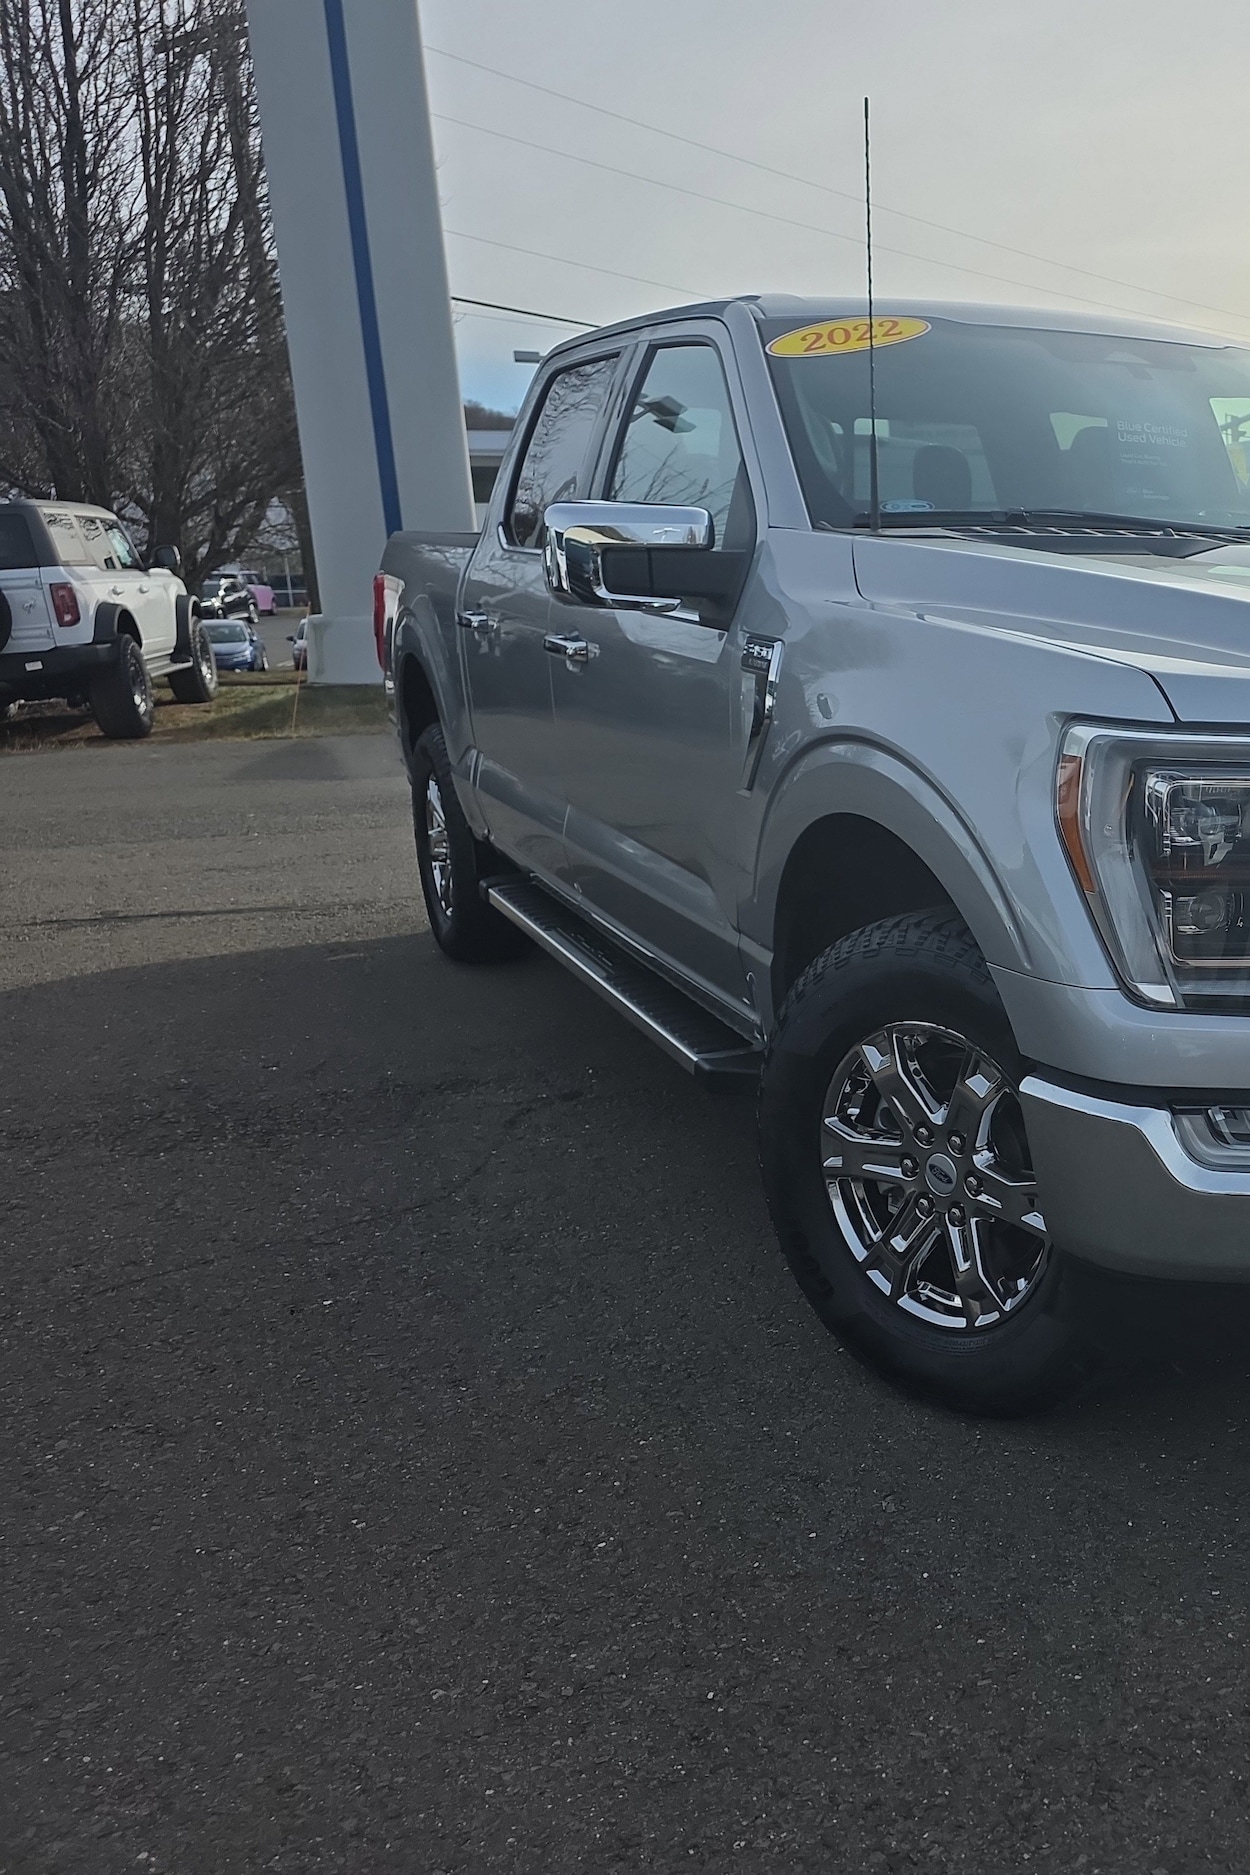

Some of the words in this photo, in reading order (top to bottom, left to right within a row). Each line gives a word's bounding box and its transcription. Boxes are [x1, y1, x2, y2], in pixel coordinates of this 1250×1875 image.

[801, 319, 903, 353] 2022
[1117, 420, 1142, 432] Blue
[1143, 422, 1188, 438] Certified
[1118, 431, 1147, 443] Used
[1148, 433, 1187, 447] Vehicle
